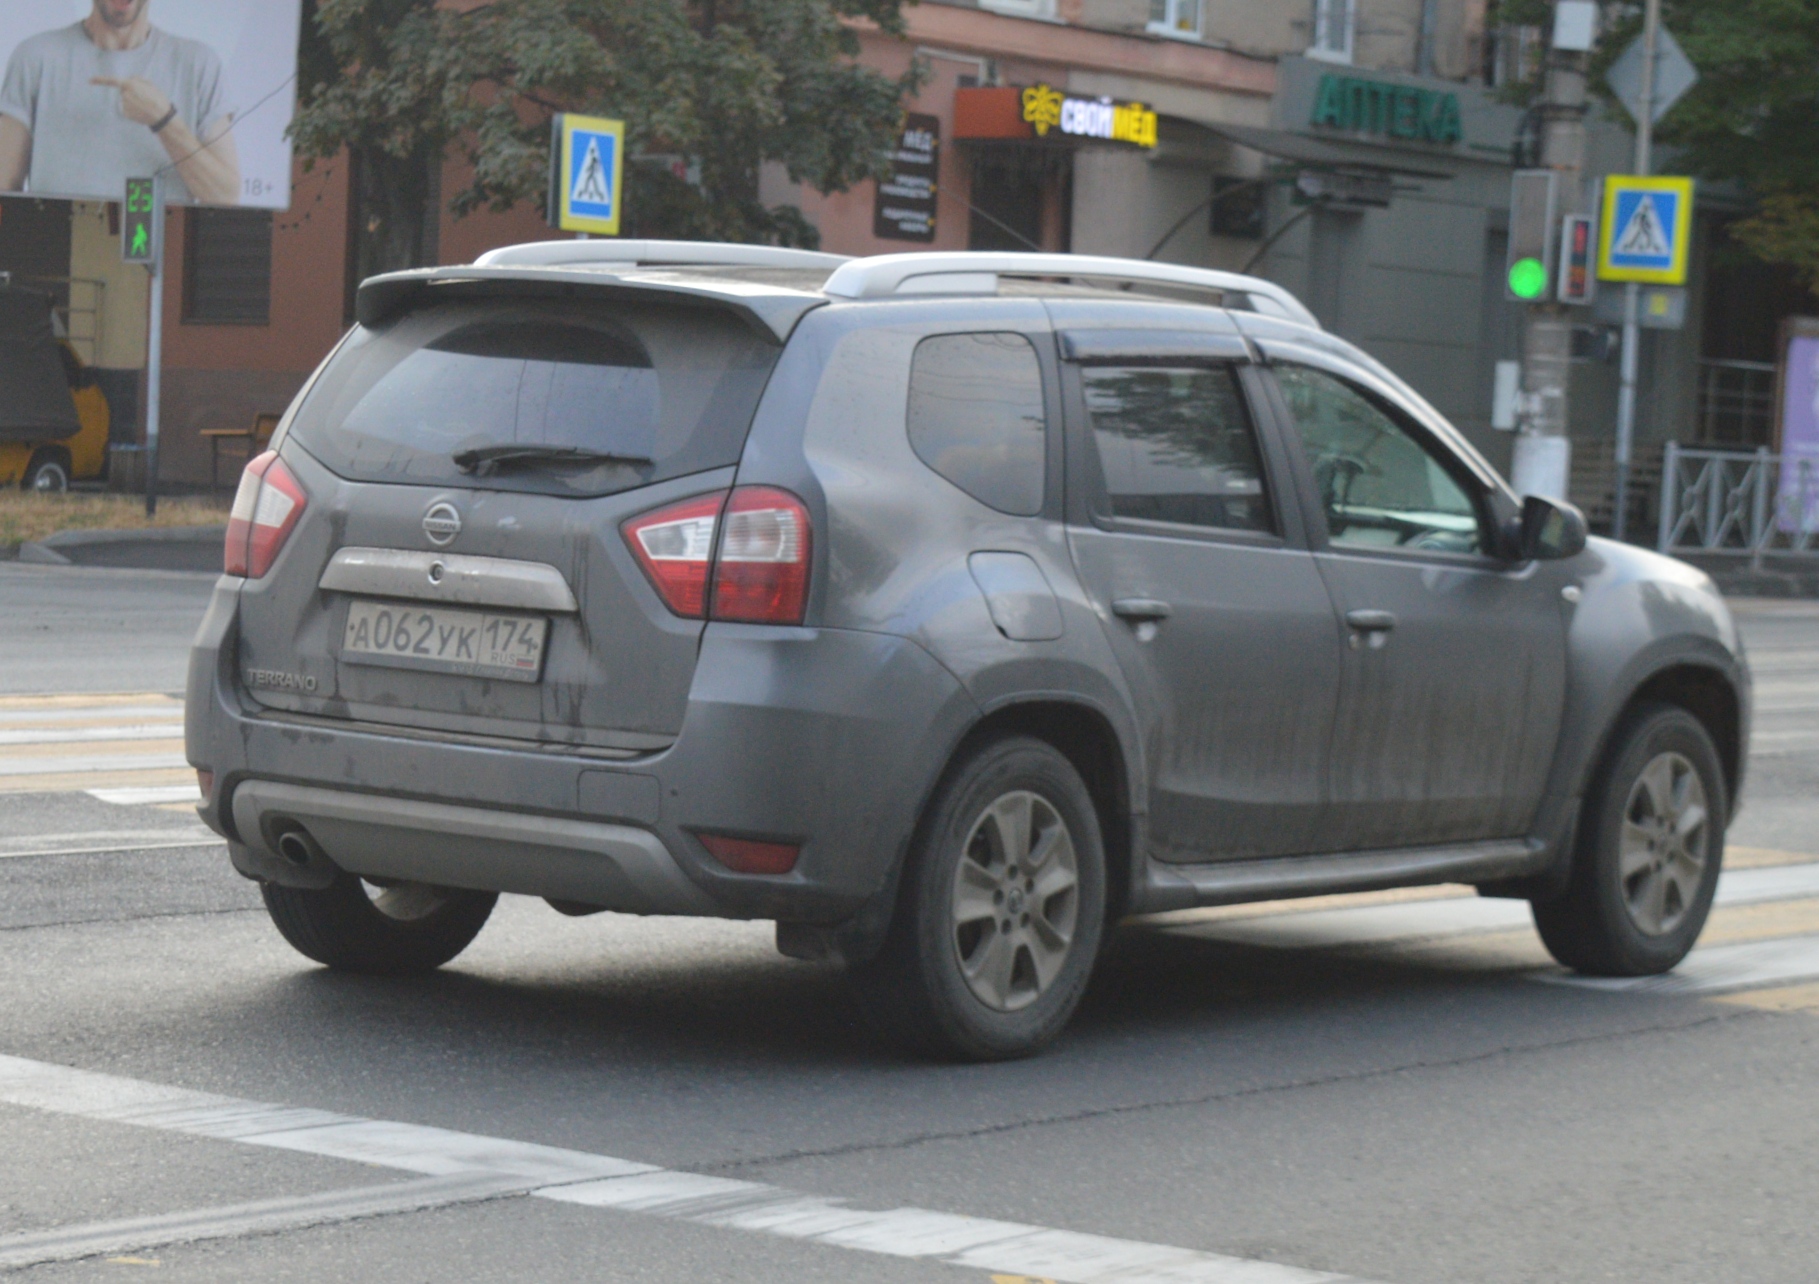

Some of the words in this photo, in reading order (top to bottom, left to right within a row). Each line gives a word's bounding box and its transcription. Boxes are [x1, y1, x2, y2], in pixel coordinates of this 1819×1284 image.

[1310, 73, 1463, 142] АПТЕКА
[244, 178, 273, 197] 18+
[485, 618, 534, 655] 174
[490, 653, 516, 666] RUS
[247, 668, 317, 691] TERRANO
